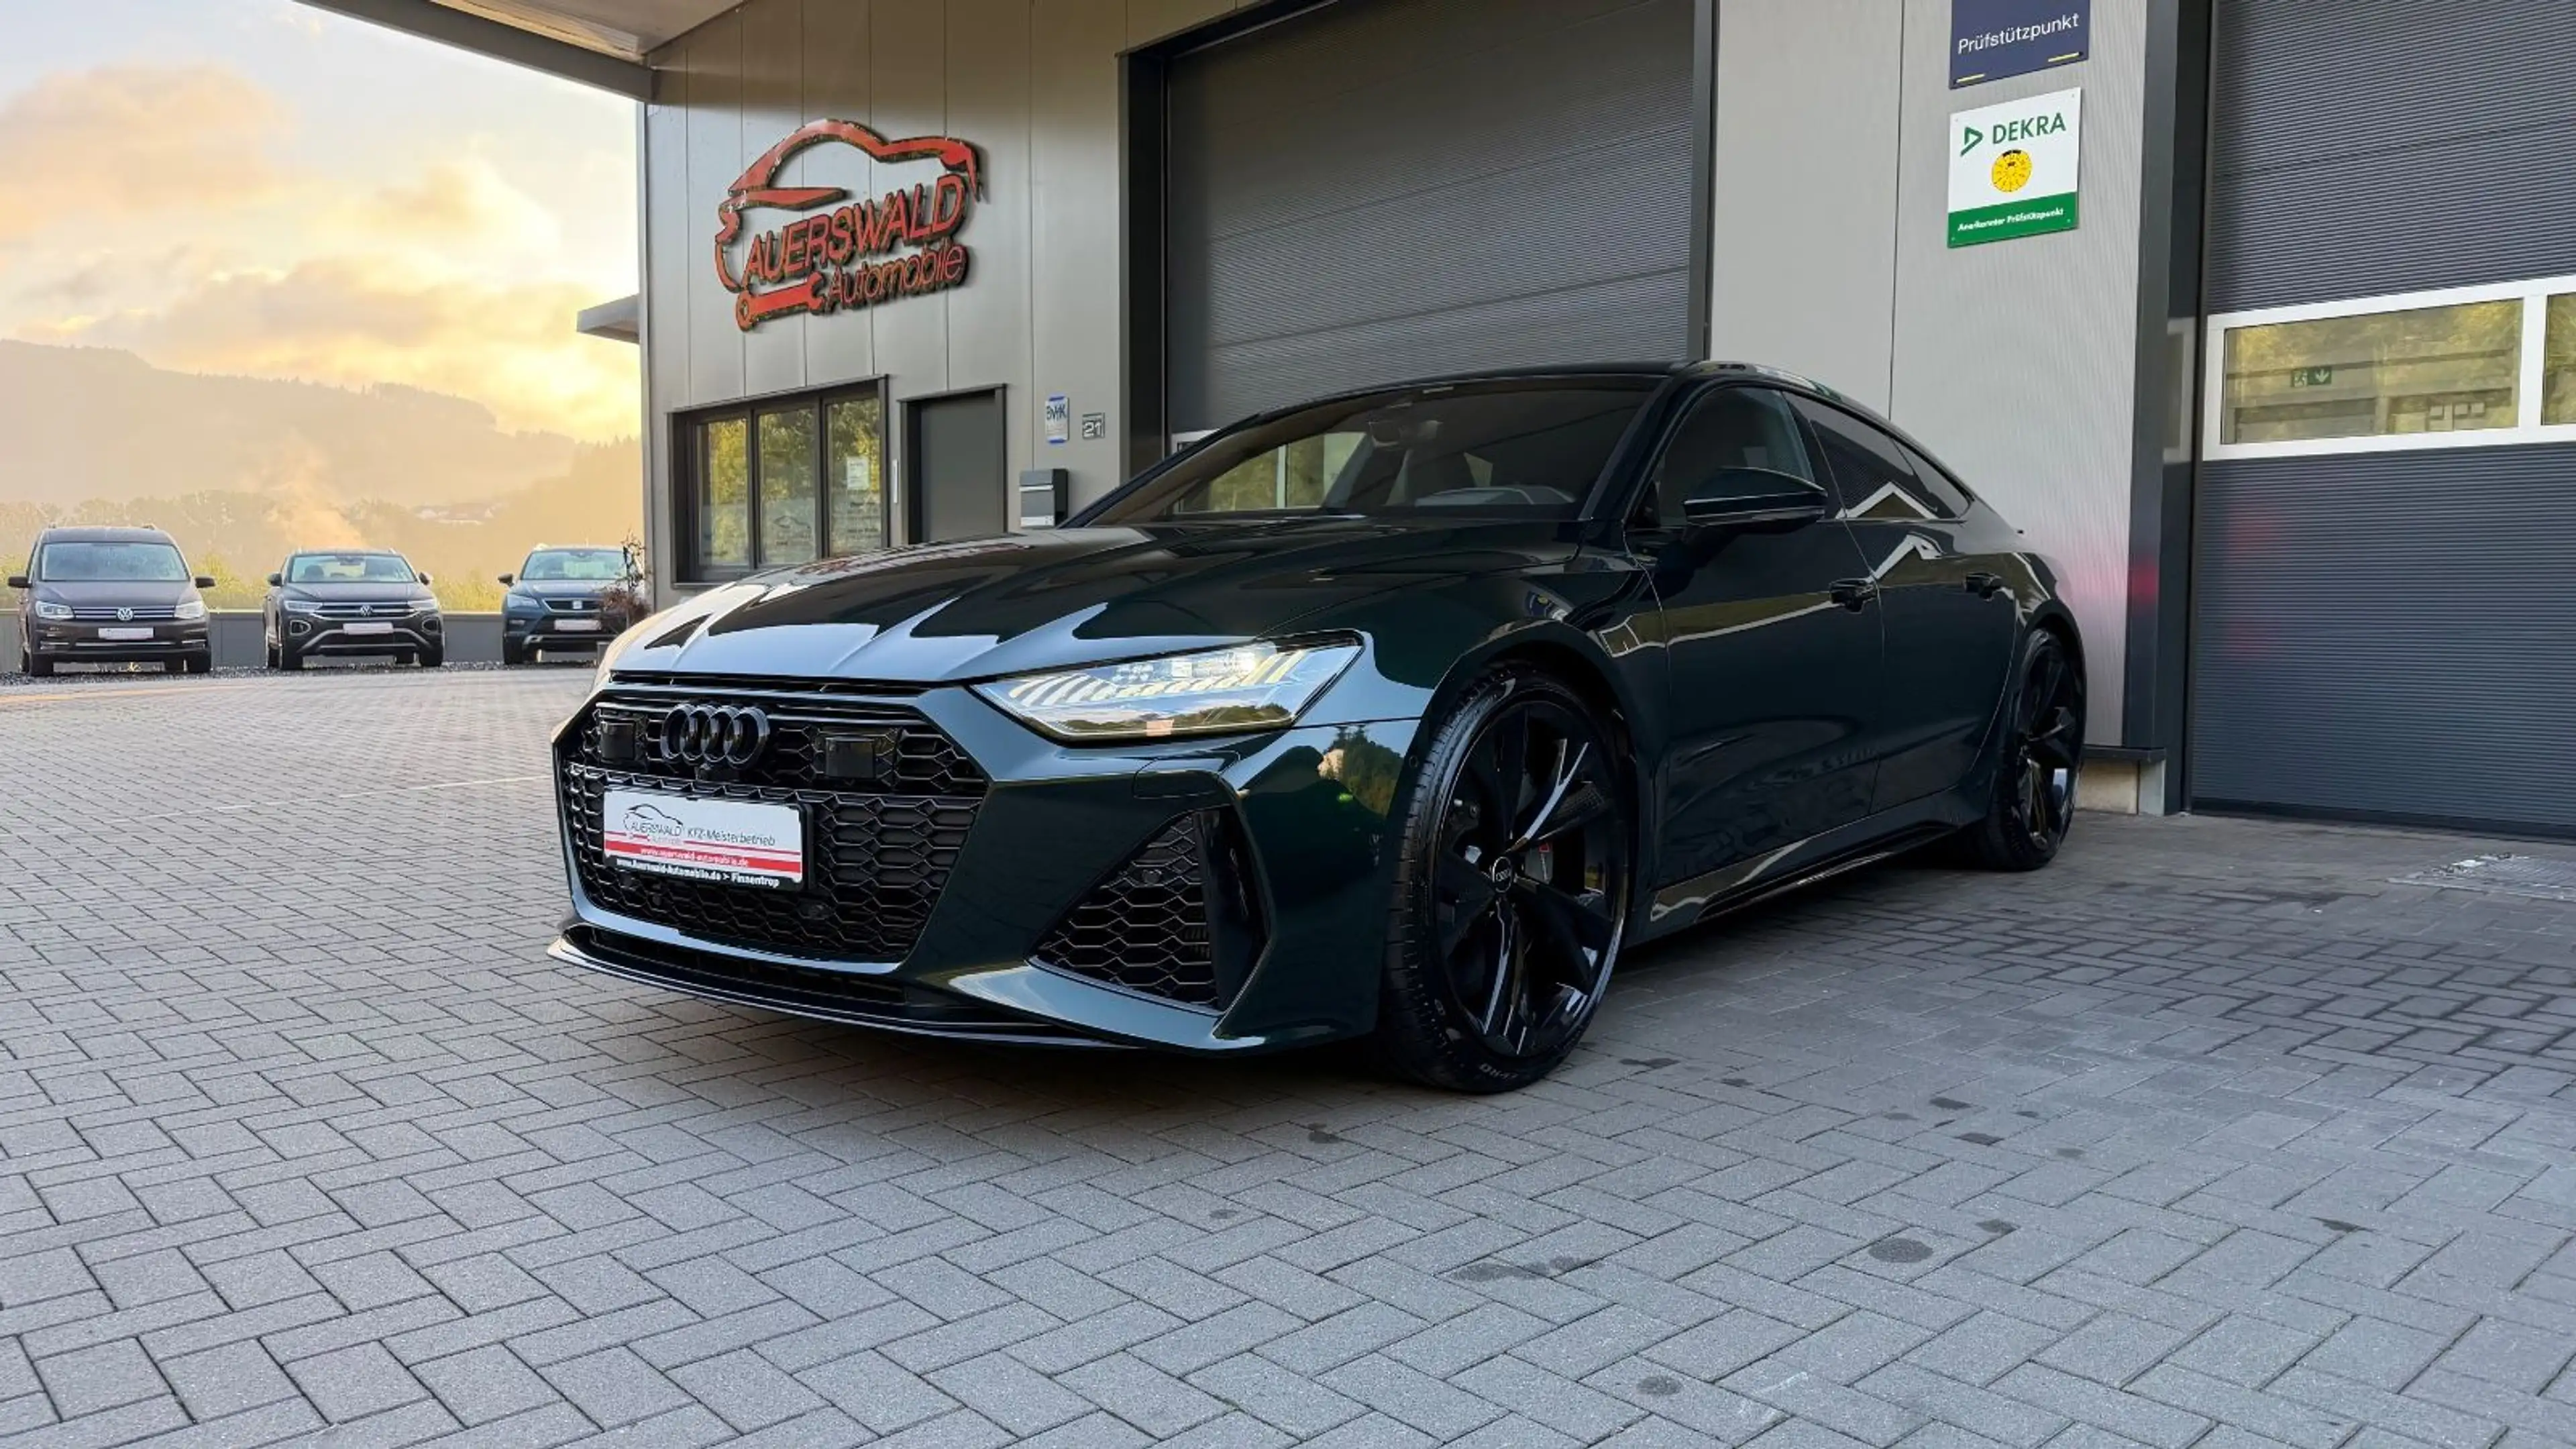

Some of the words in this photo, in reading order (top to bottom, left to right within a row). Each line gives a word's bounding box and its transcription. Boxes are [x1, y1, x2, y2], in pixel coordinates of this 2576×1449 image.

[1957, 13, 2080, 54] Prüfstützpunkt
[1992, 112, 2066, 145] DEKRA
[743, 174, 967, 284] AUERSWALD
[826, 243, 969, 306] Automobile
[1083, 421, 1103, 438] 21
[687, 827, 776, 847] KFZ-Meisterbetrieb
[731, 872, 780, 888] Finnentrop
